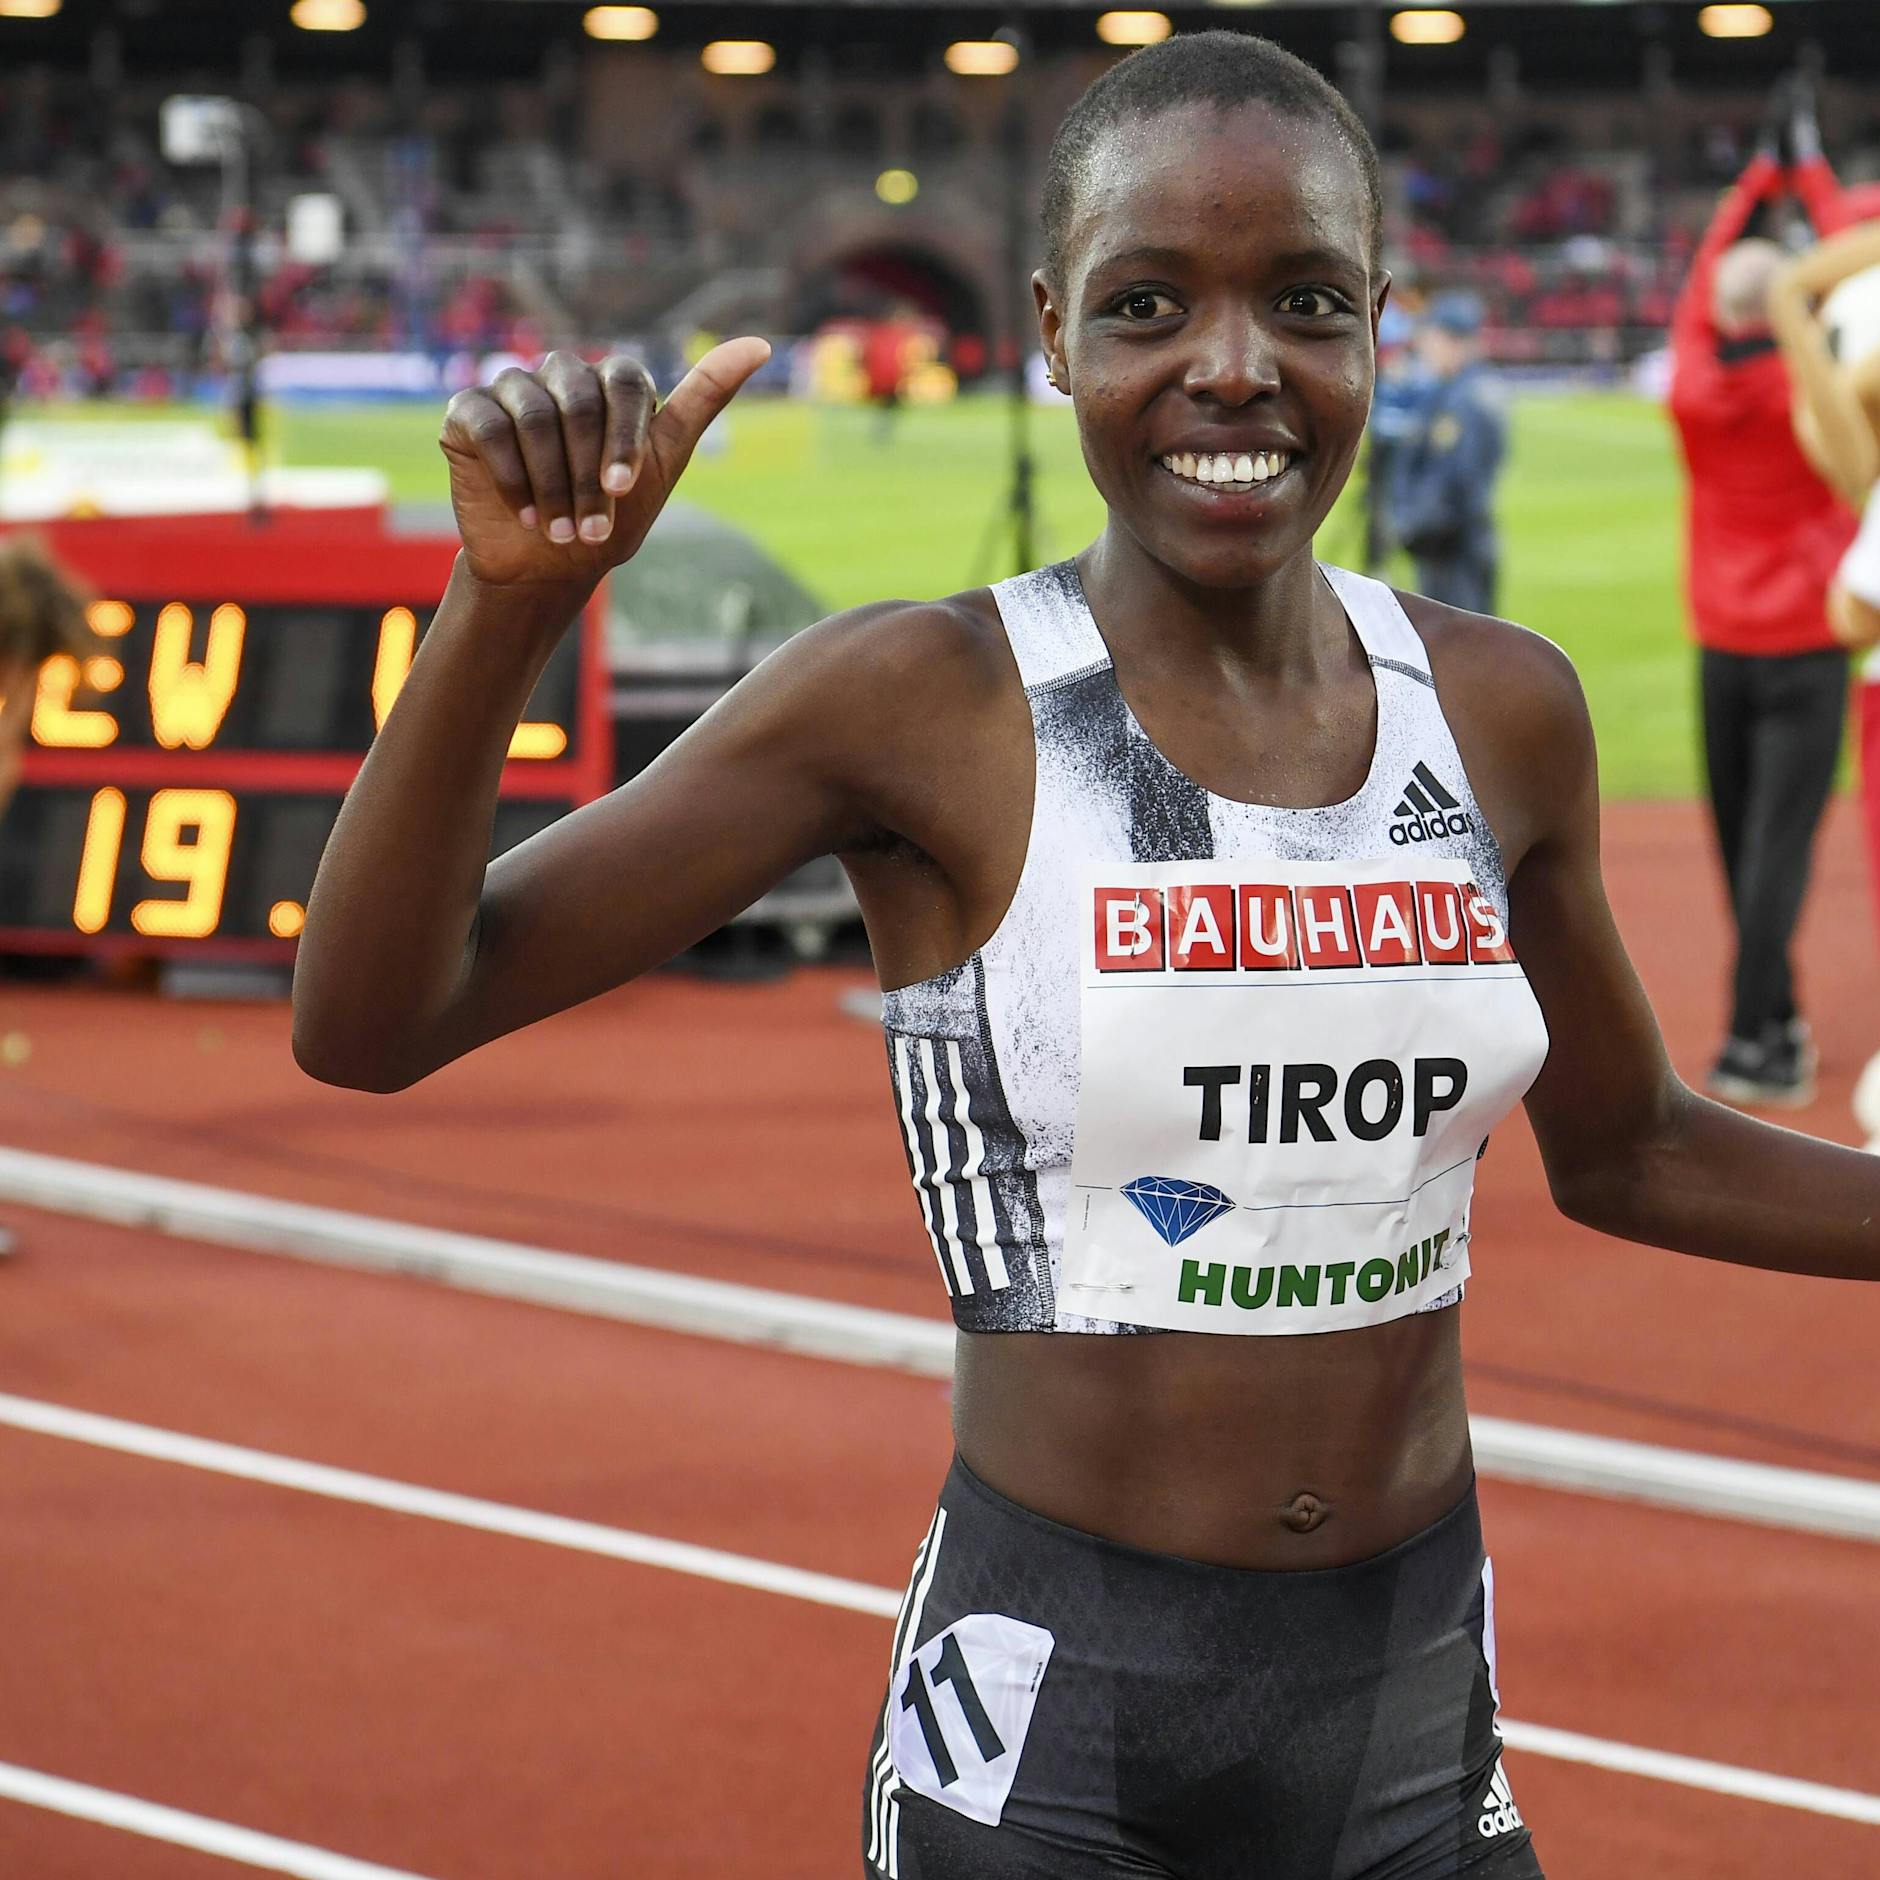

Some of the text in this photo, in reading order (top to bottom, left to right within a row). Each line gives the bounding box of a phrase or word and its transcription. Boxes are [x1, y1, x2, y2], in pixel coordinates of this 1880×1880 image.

[1389, 809, 1475, 846] adidas
[1104, 890, 1506, 958] BAUHAUS
[1183, 1057, 1468, 1144] TIROP
[1177, 1226, 1451, 1310] HUNTONIT
[900, 1632, 1006, 1789] 11
[1477, 1801, 1525, 1838] adid
